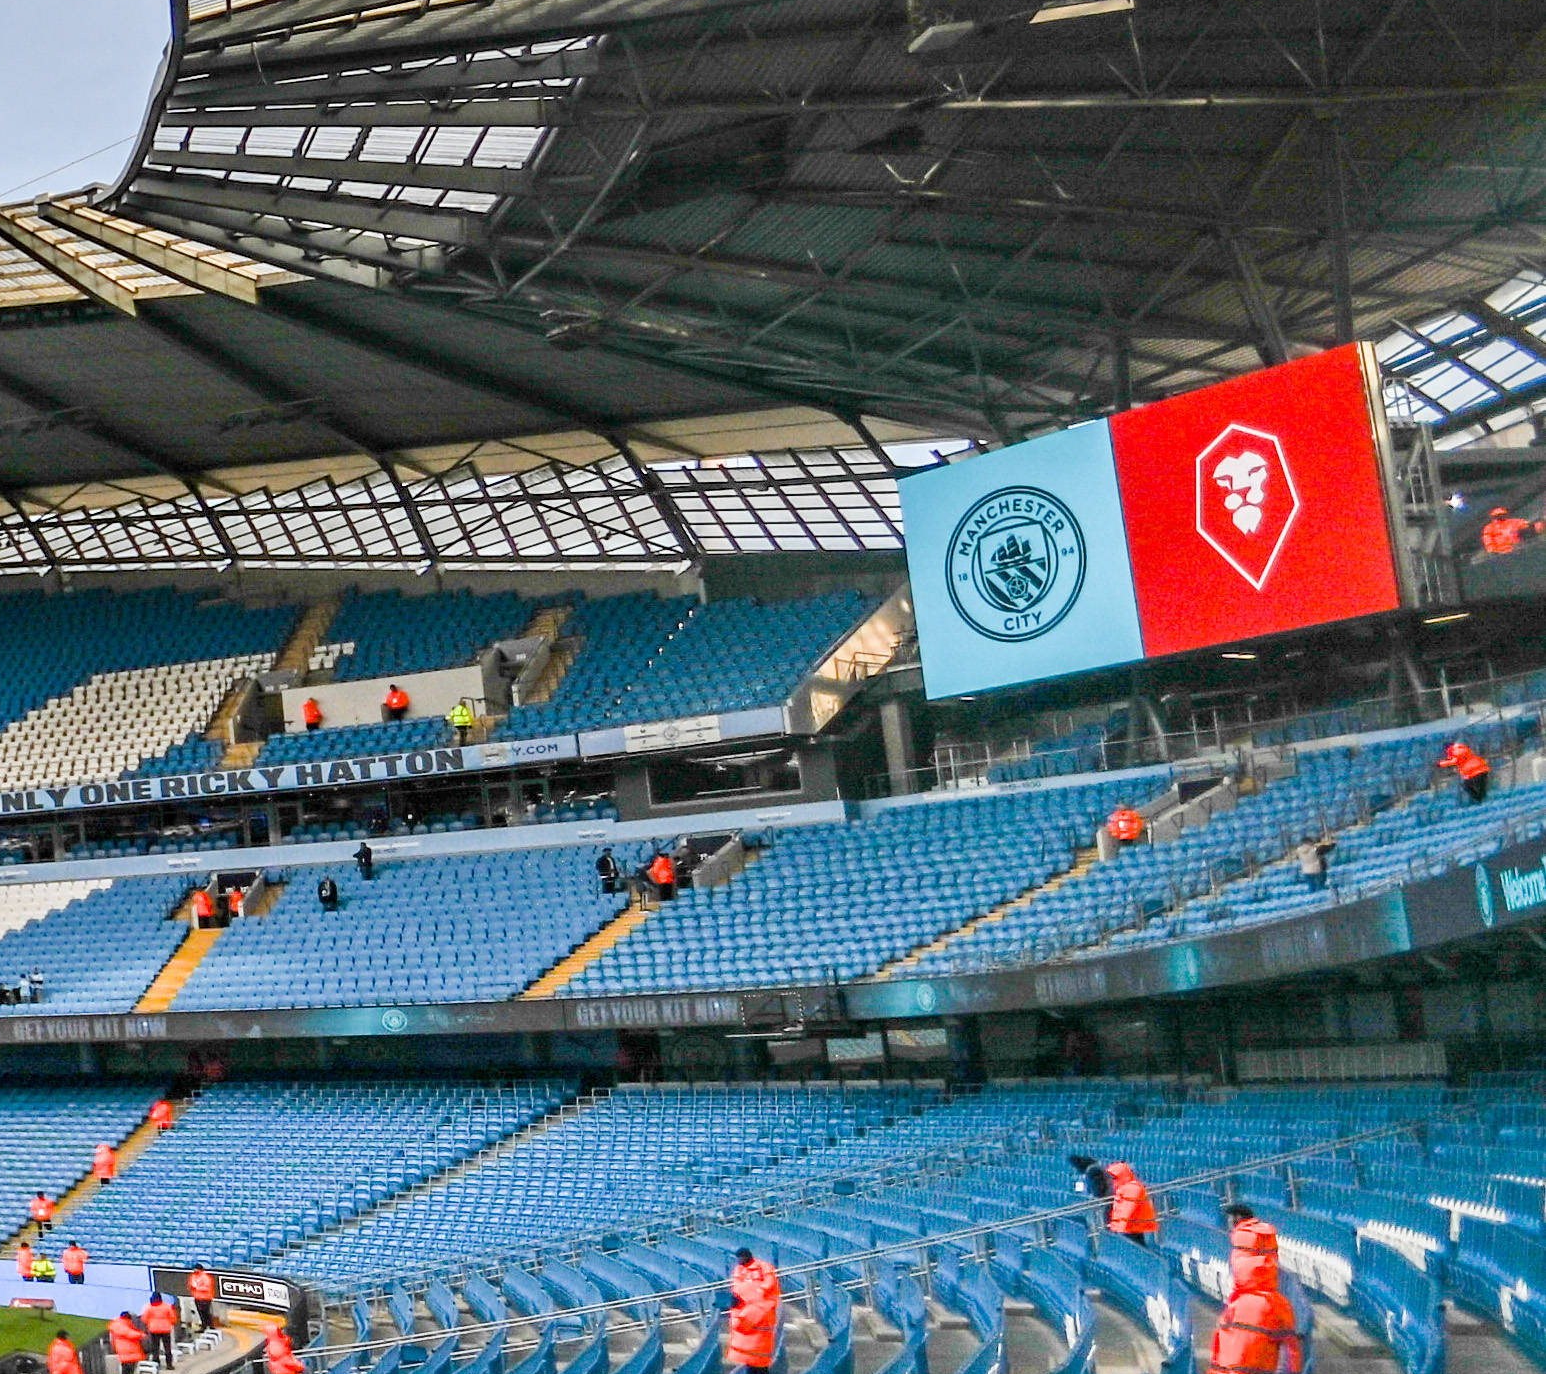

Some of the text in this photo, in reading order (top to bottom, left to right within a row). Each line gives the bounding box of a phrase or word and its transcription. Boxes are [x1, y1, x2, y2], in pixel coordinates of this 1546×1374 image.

[959, 499, 1064, 556] MANCHESTER
[1004, 611, 1041, 631] CITY
[79, 779, 152, 805] ONE
[160, 766, 283, 798] RICKY
[297, 747, 464, 786] HATTON
[576, 997, 739, 1026] GET YOUR KIT NOW
[13, 1016, 167, 1040] GET YOUR KIT NOW
[223, 1282, 262, 1295] ETIHAD
